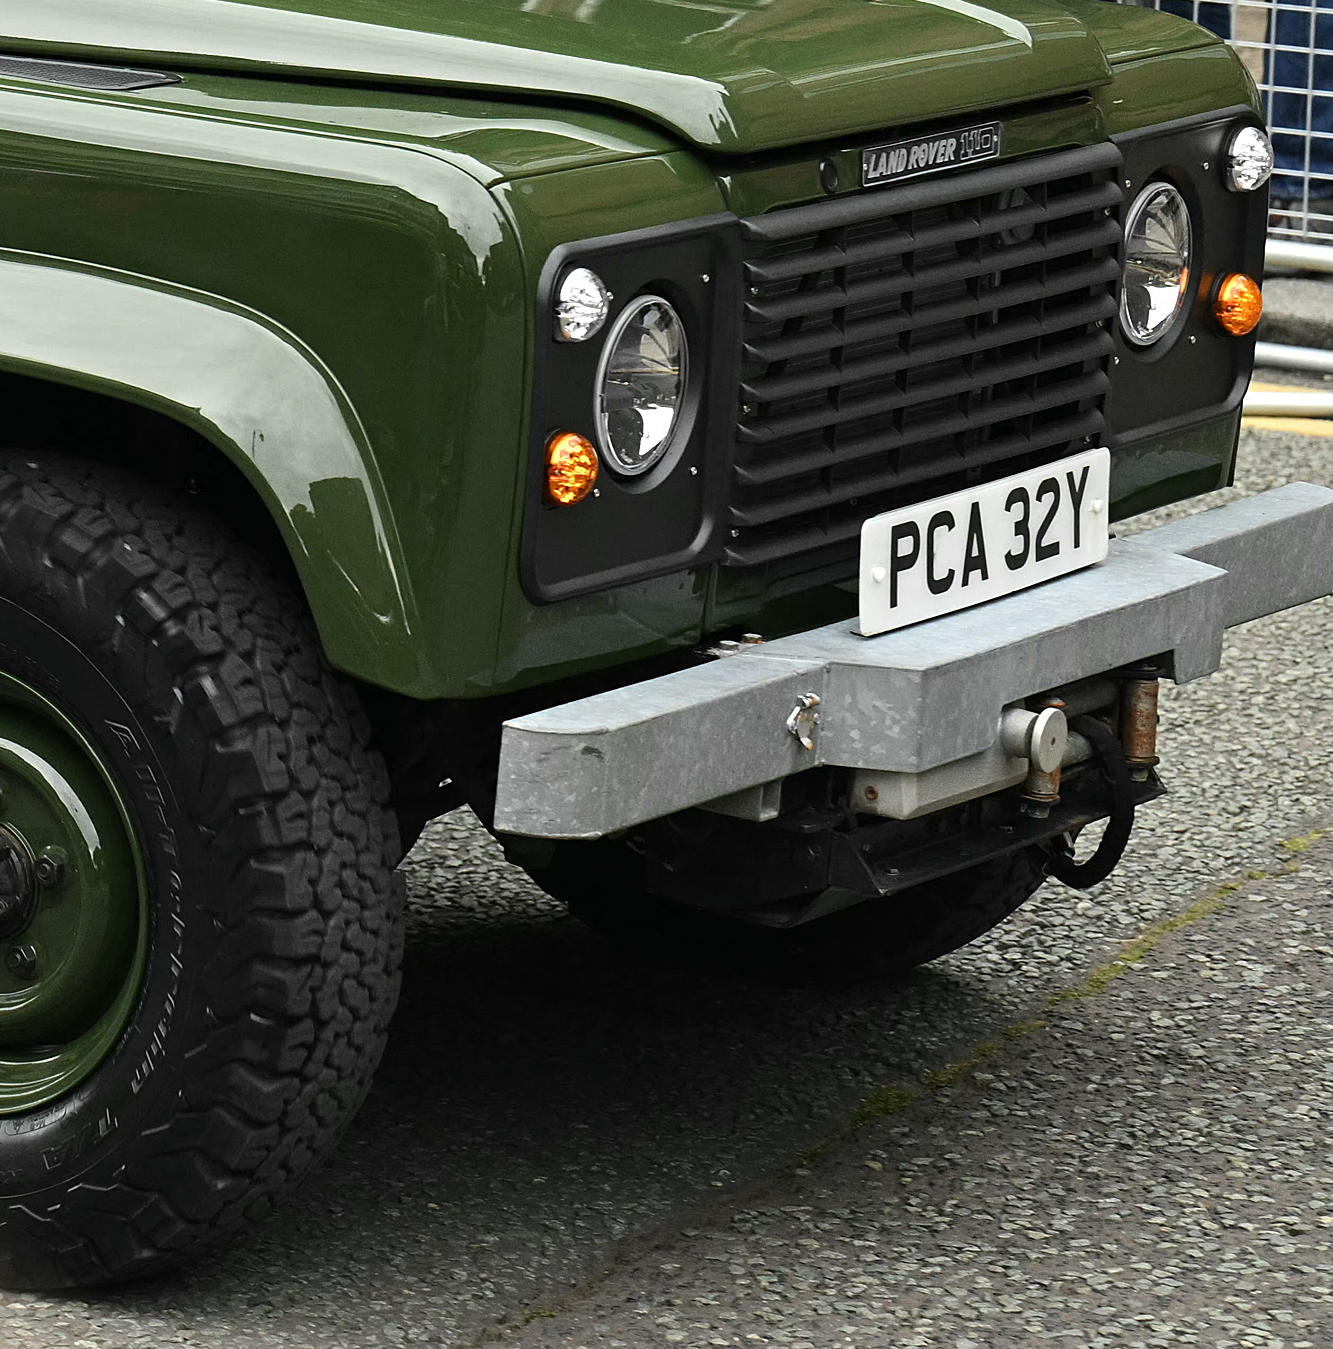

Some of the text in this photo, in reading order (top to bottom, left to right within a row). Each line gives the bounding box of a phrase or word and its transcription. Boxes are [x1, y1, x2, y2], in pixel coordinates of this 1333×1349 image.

[867, 127, 995, 179] LAND ROVER 110
[889, 465, 1090, 609] PCA 32Y
